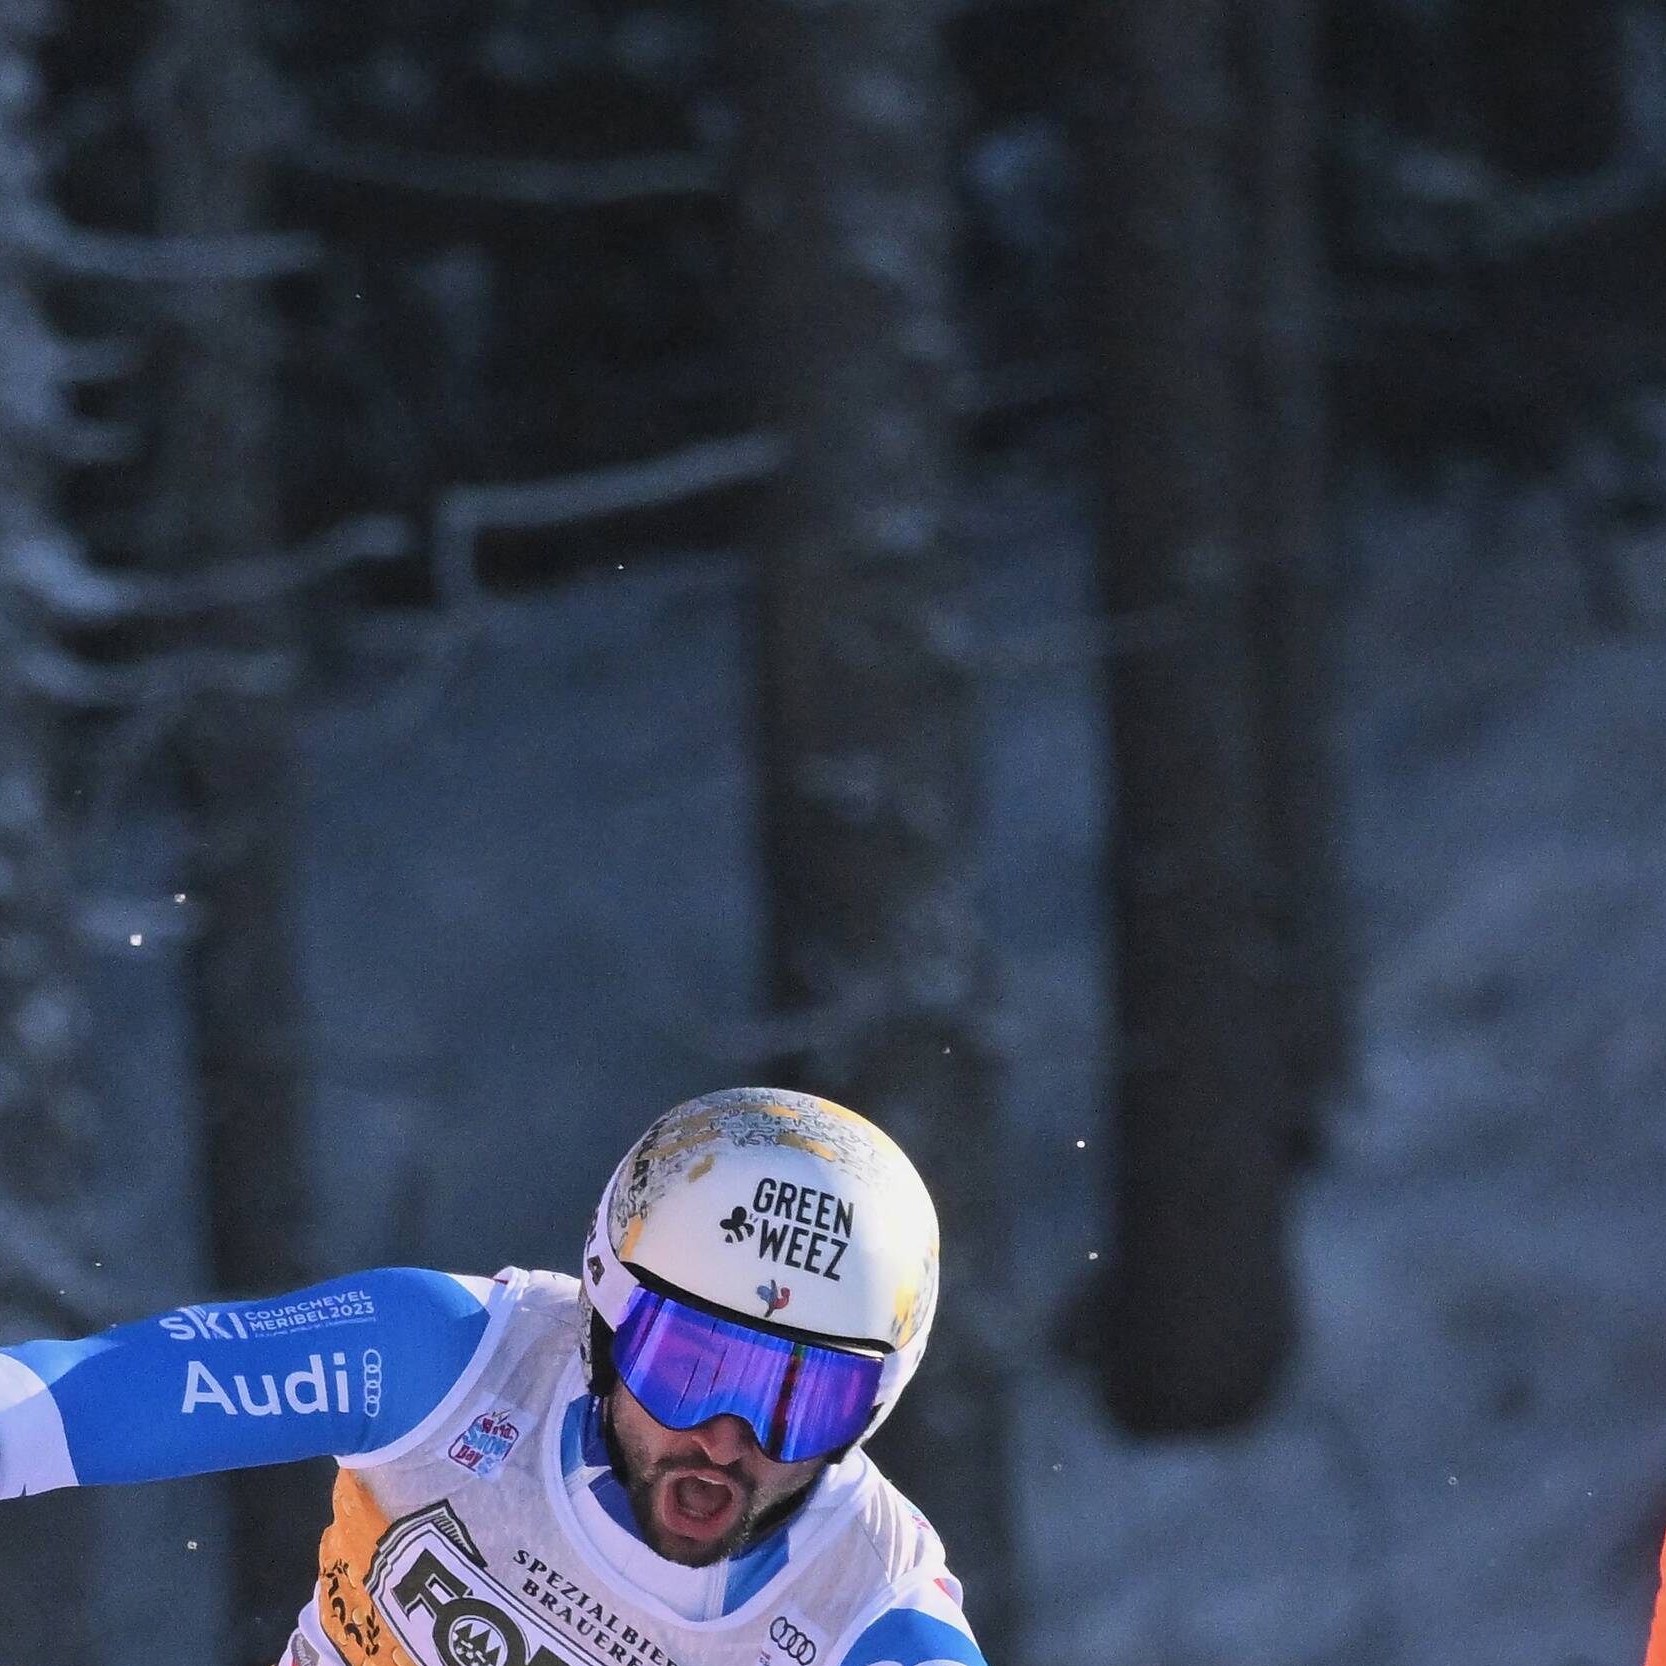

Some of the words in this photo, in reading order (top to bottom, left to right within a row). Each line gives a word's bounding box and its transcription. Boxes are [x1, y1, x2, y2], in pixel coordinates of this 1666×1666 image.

[752, 1177, 854, 1239] GREEN
[759, 1223, 849, 1282] WEEZ
[159, 1305, 249, 1340] SKI
[245, 1289, 372, 1321] COURCHEVEL
[181, 1352, 350, 1417] Audi
